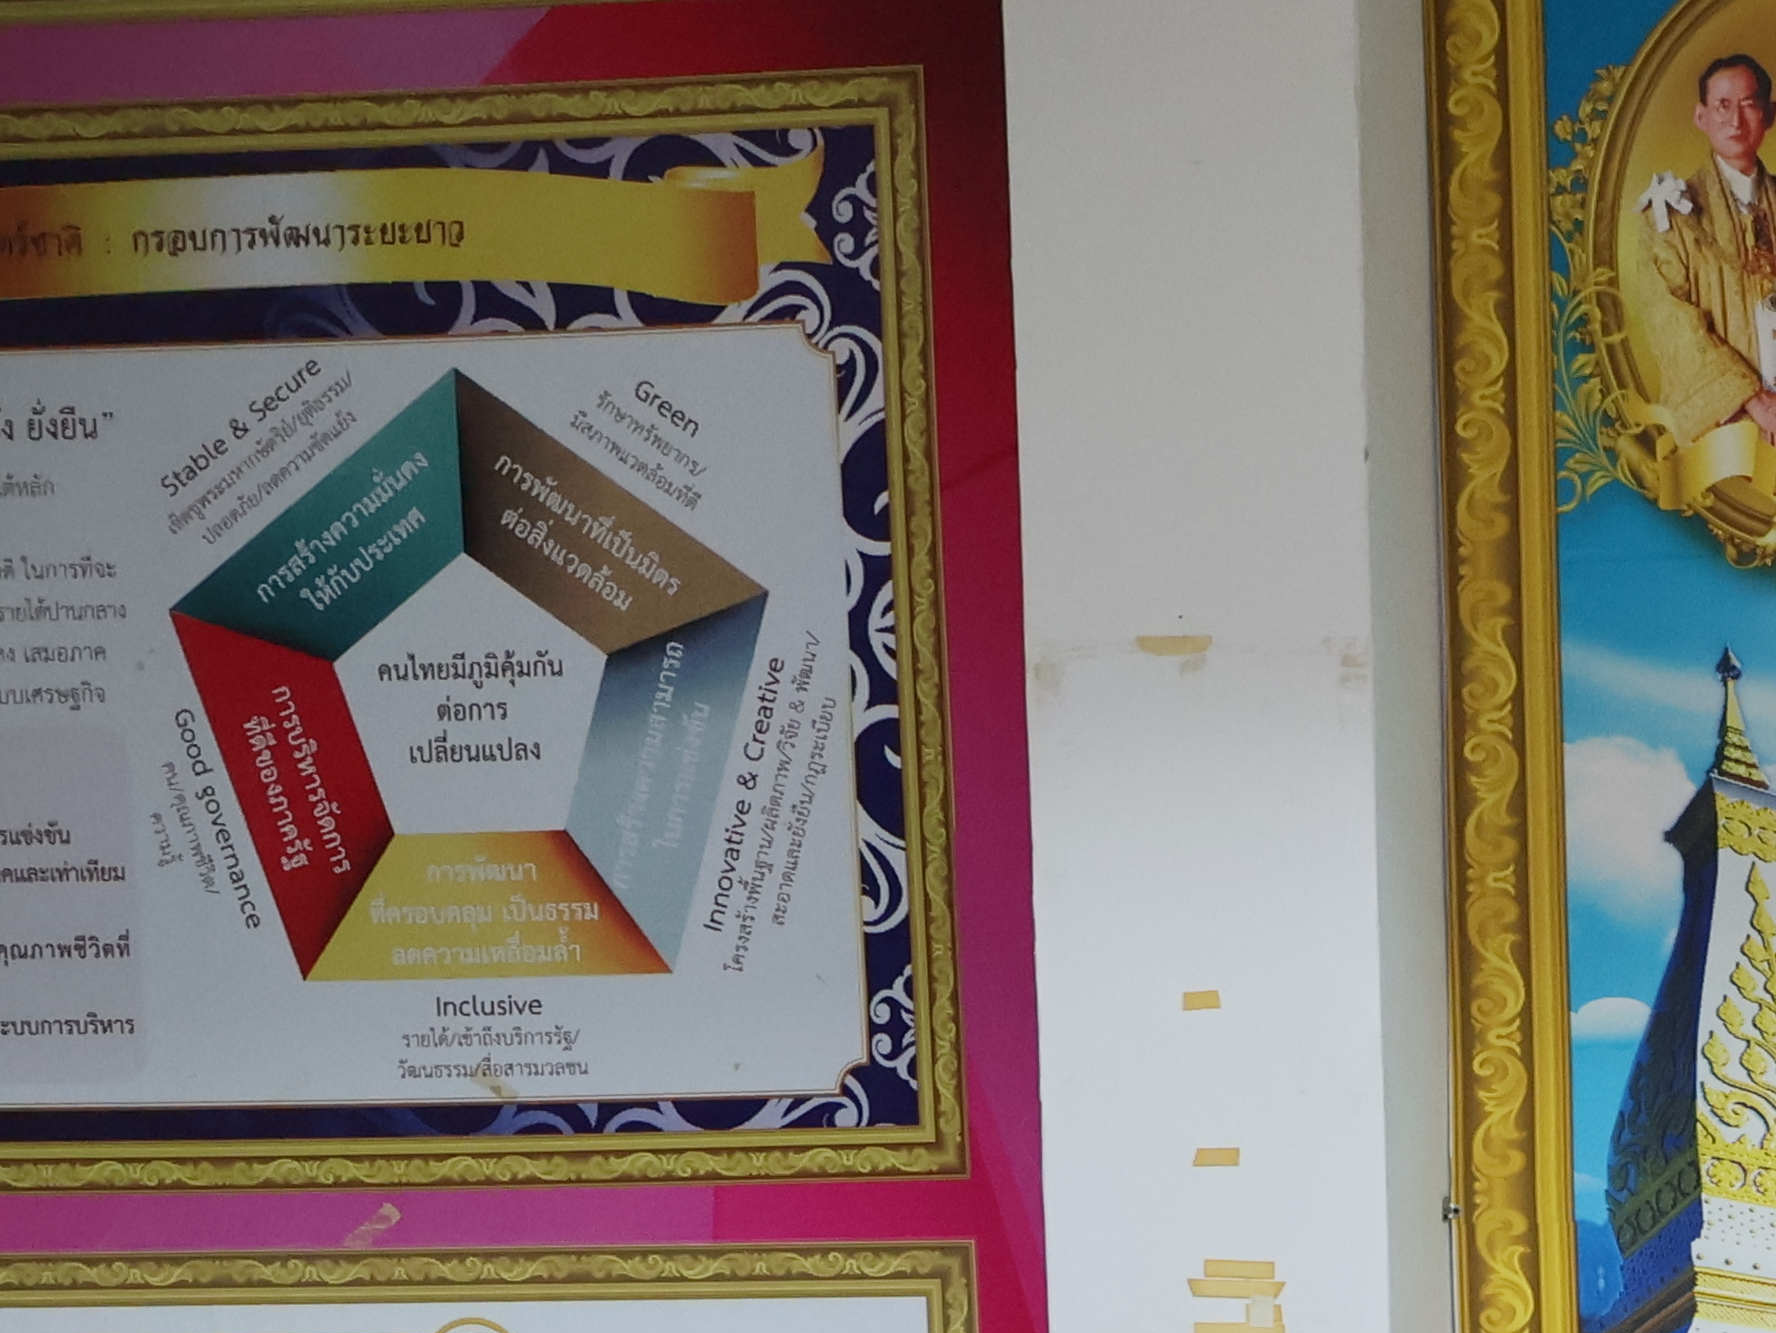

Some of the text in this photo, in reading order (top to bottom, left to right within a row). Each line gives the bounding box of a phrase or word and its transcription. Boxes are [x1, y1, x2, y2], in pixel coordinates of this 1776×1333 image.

[131, 213, 466, 258] กรอบการพัฒนาระยะยาว
[161, 359, 323, 497] Stable & Secure
[635, 380, 701, 438] Green
[256, 451, 429, 604] การสร้างความมั่นคง
[494, 455, 682, 598] การพัฒนาที่เป็นมิตร
[300, 506, 427, 612] ให้กับประเทศ
[500, 506, 634, 612] ต่อสิ่งแวดล้อม
[24, 645, 107, 664] เสมอภาค
[377, 650, 564, 690] คนไทยมีภูมิคุ้มกัน
[436, 696, 508, 722] ต่อการ
[409, 729, 541, 764] เปลี่ยนแปลง
[271, 685, 351, 875] การบริหารจัดการ
[702, 656, 786, 934] Innovative & Creative
[174, 708, 262, 931] Good governance
[426, 855, 538, 883] การพัฒนา
[369, 893, 600, 935] ที่ครอบคลุม เป็นธรรม
[435, 994, 543, 1018] Inclusive
